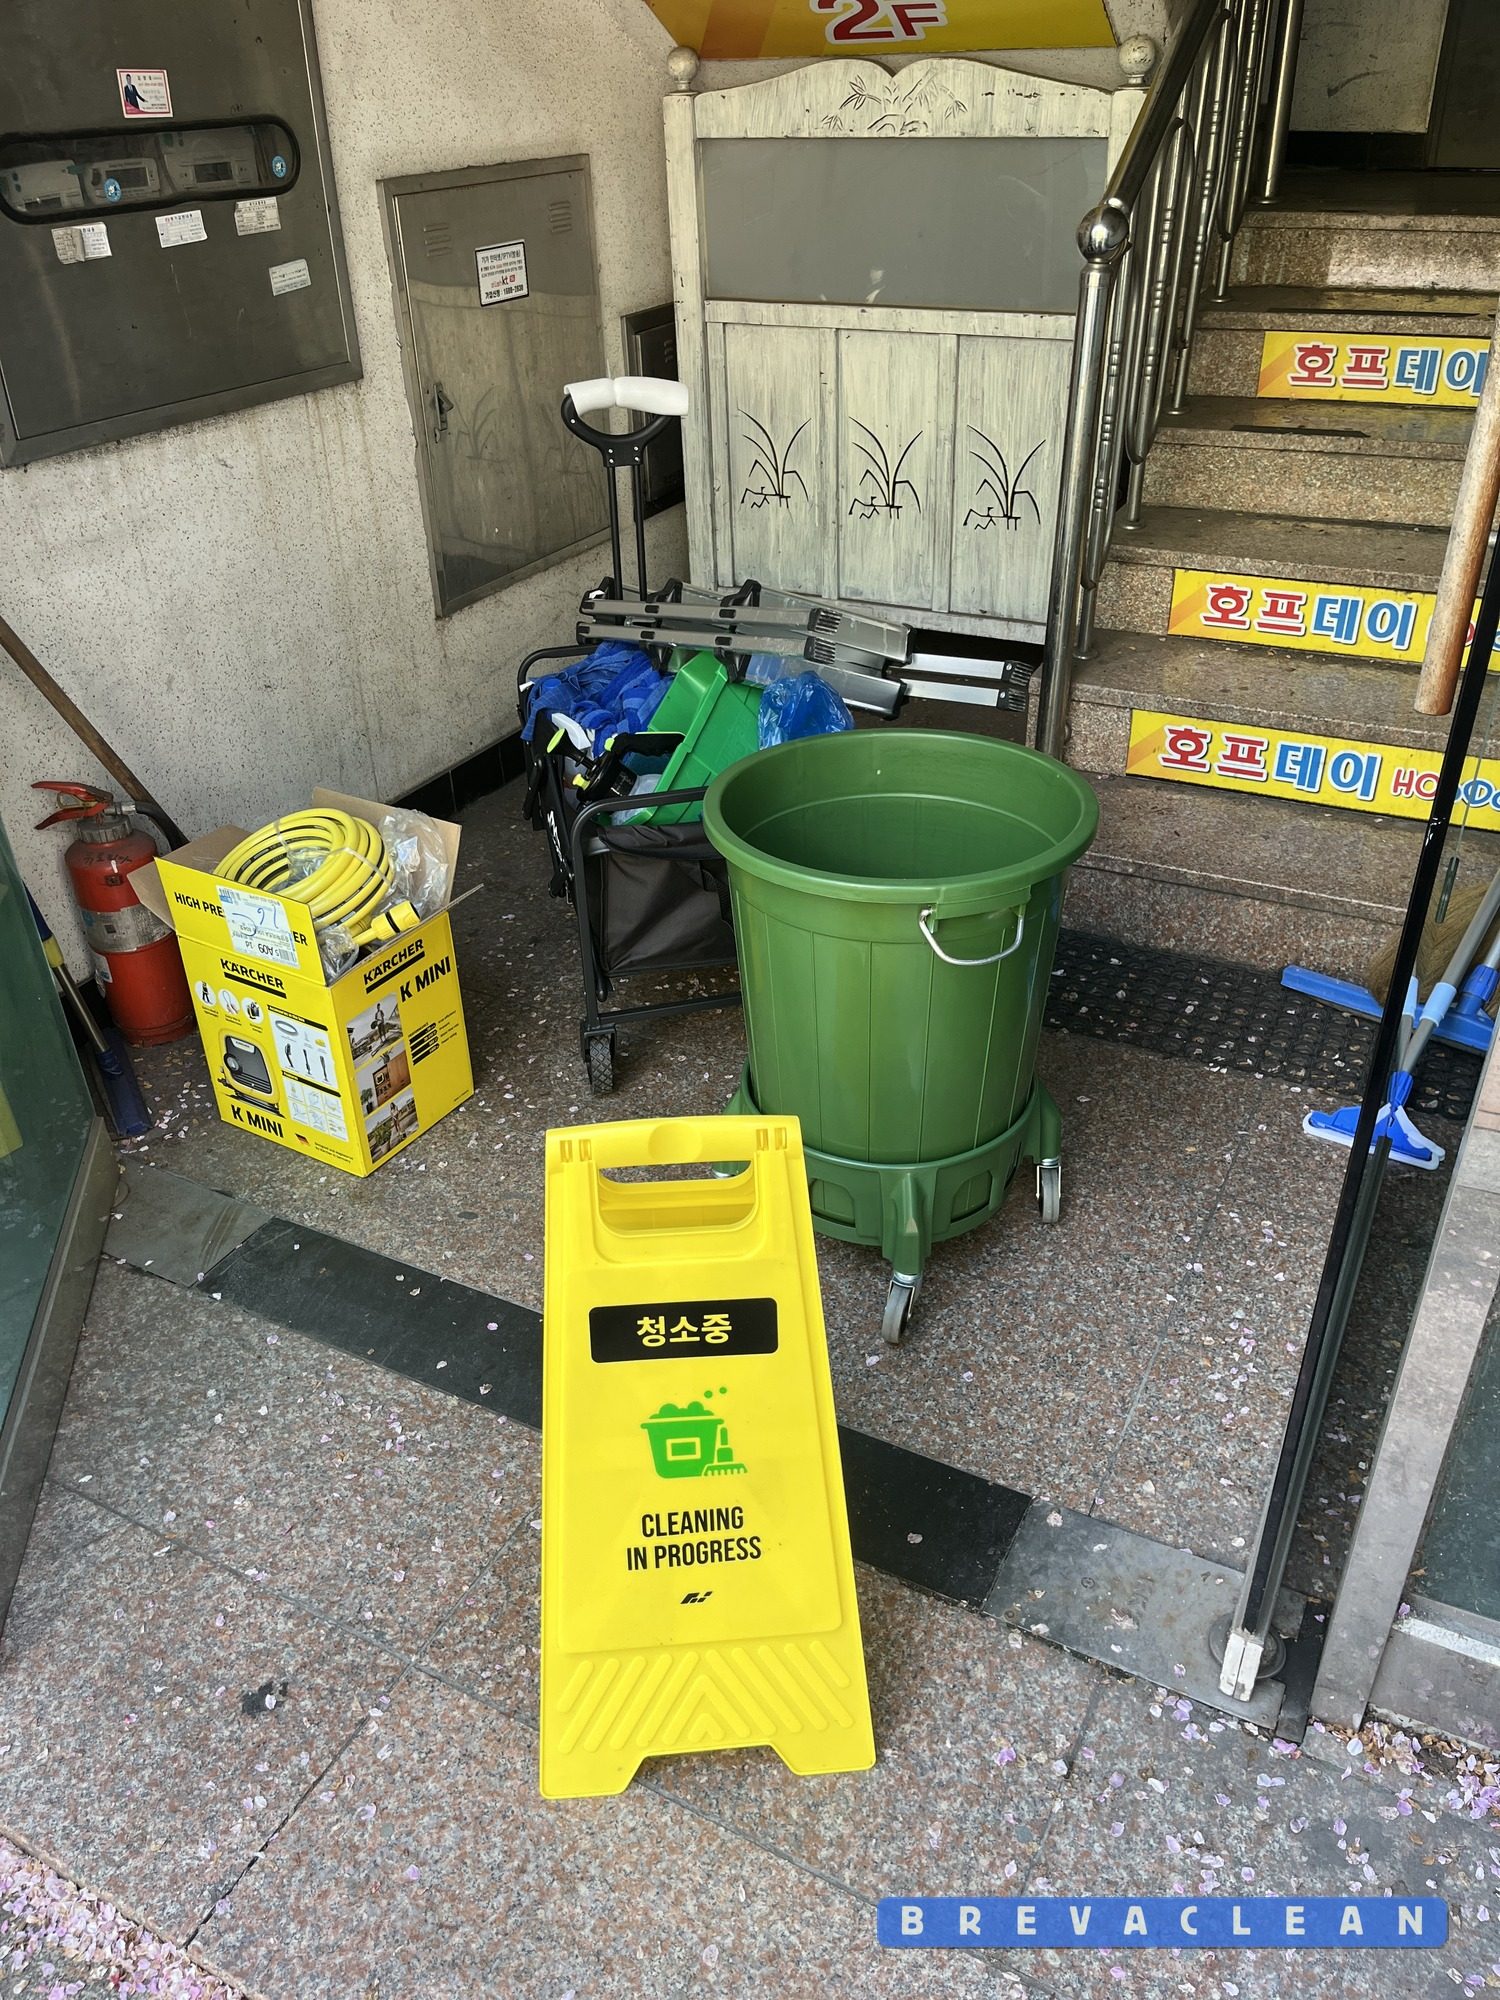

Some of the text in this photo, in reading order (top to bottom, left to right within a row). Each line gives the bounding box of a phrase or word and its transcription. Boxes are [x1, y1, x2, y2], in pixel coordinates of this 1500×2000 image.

[812, 0, 943, 43] 2F
[1289, 344, 1489, 395] 호프데이
[1202, 585, 1414, 647] 호프데이
[1160, 728, 1379, 798] 호프데이
[174, 892, 201, 910] HIGH
[220, 958, 285, 990] KÄRCHER
[363, 938, 424, 985] KÄRCHER
[400, 956, 451, 1003] K MINI
[231, 1104, 283, 1138] K MINI
[636, 1313, 733, 1347] 청소중
[641, 1506, 744, 1538] CLEANING
[626, 1536, 762, 1571] IN PROGRESS
